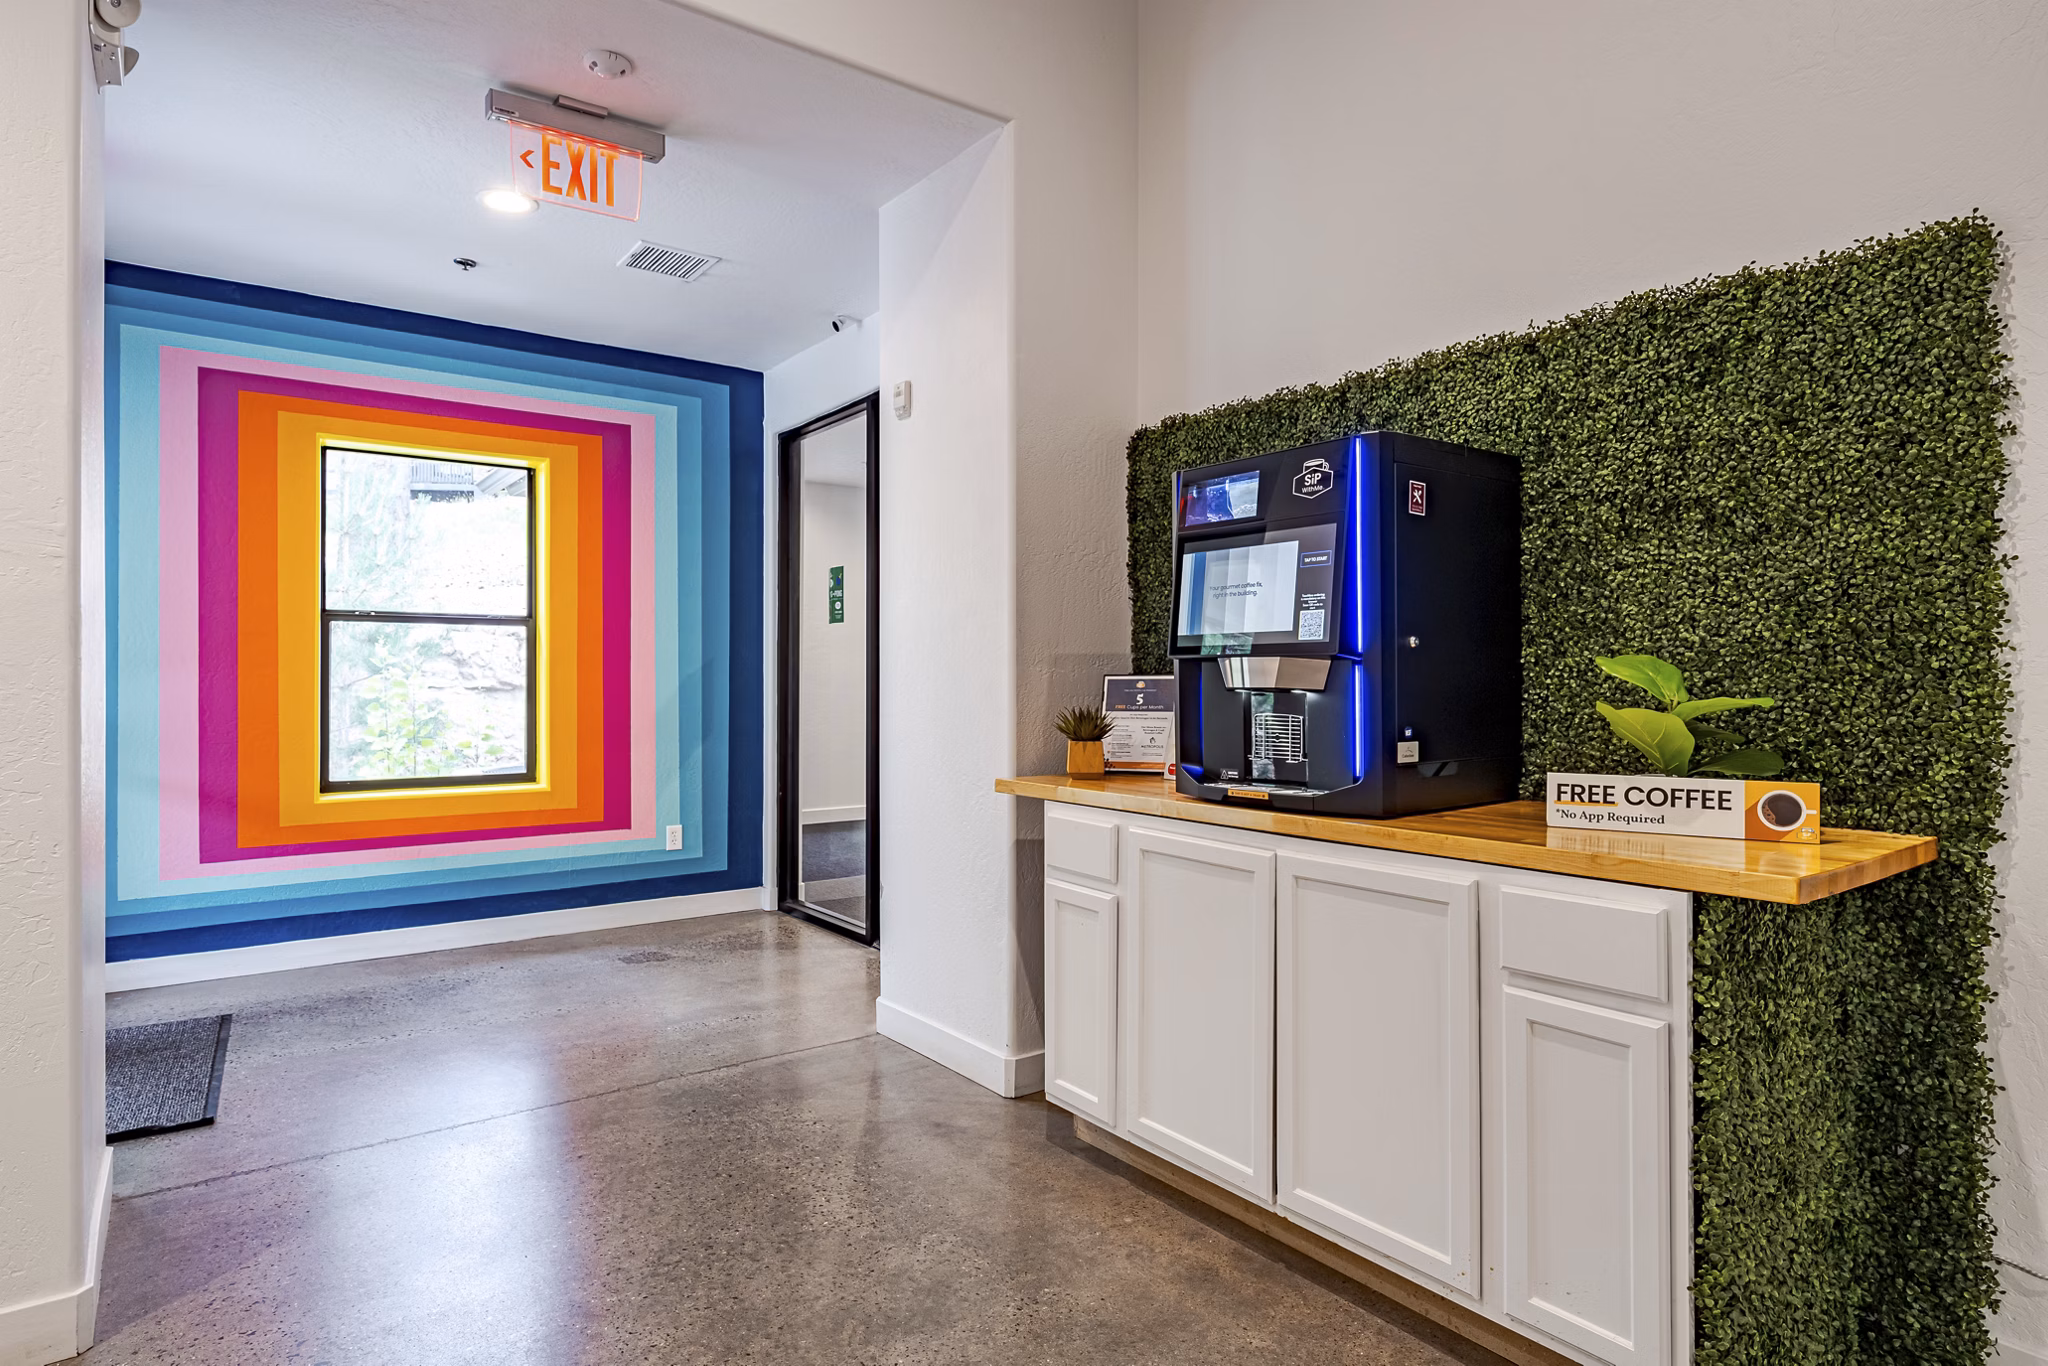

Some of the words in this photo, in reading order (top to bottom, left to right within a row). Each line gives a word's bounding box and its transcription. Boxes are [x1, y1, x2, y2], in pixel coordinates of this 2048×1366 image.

[541, 133, 620, 207] EXIT
[1304, 473, 1321, 486] SiP
[1220, 583, 1240, 591] gourmet
[1136, 693, 1144, 705] 5
[1556, 783, 1616, 805] FREE
[1623, 786, 1732, 811] COFFEE
[1579, 810, 1604, 823] App
[1607, 812, 1665, 825] Required
